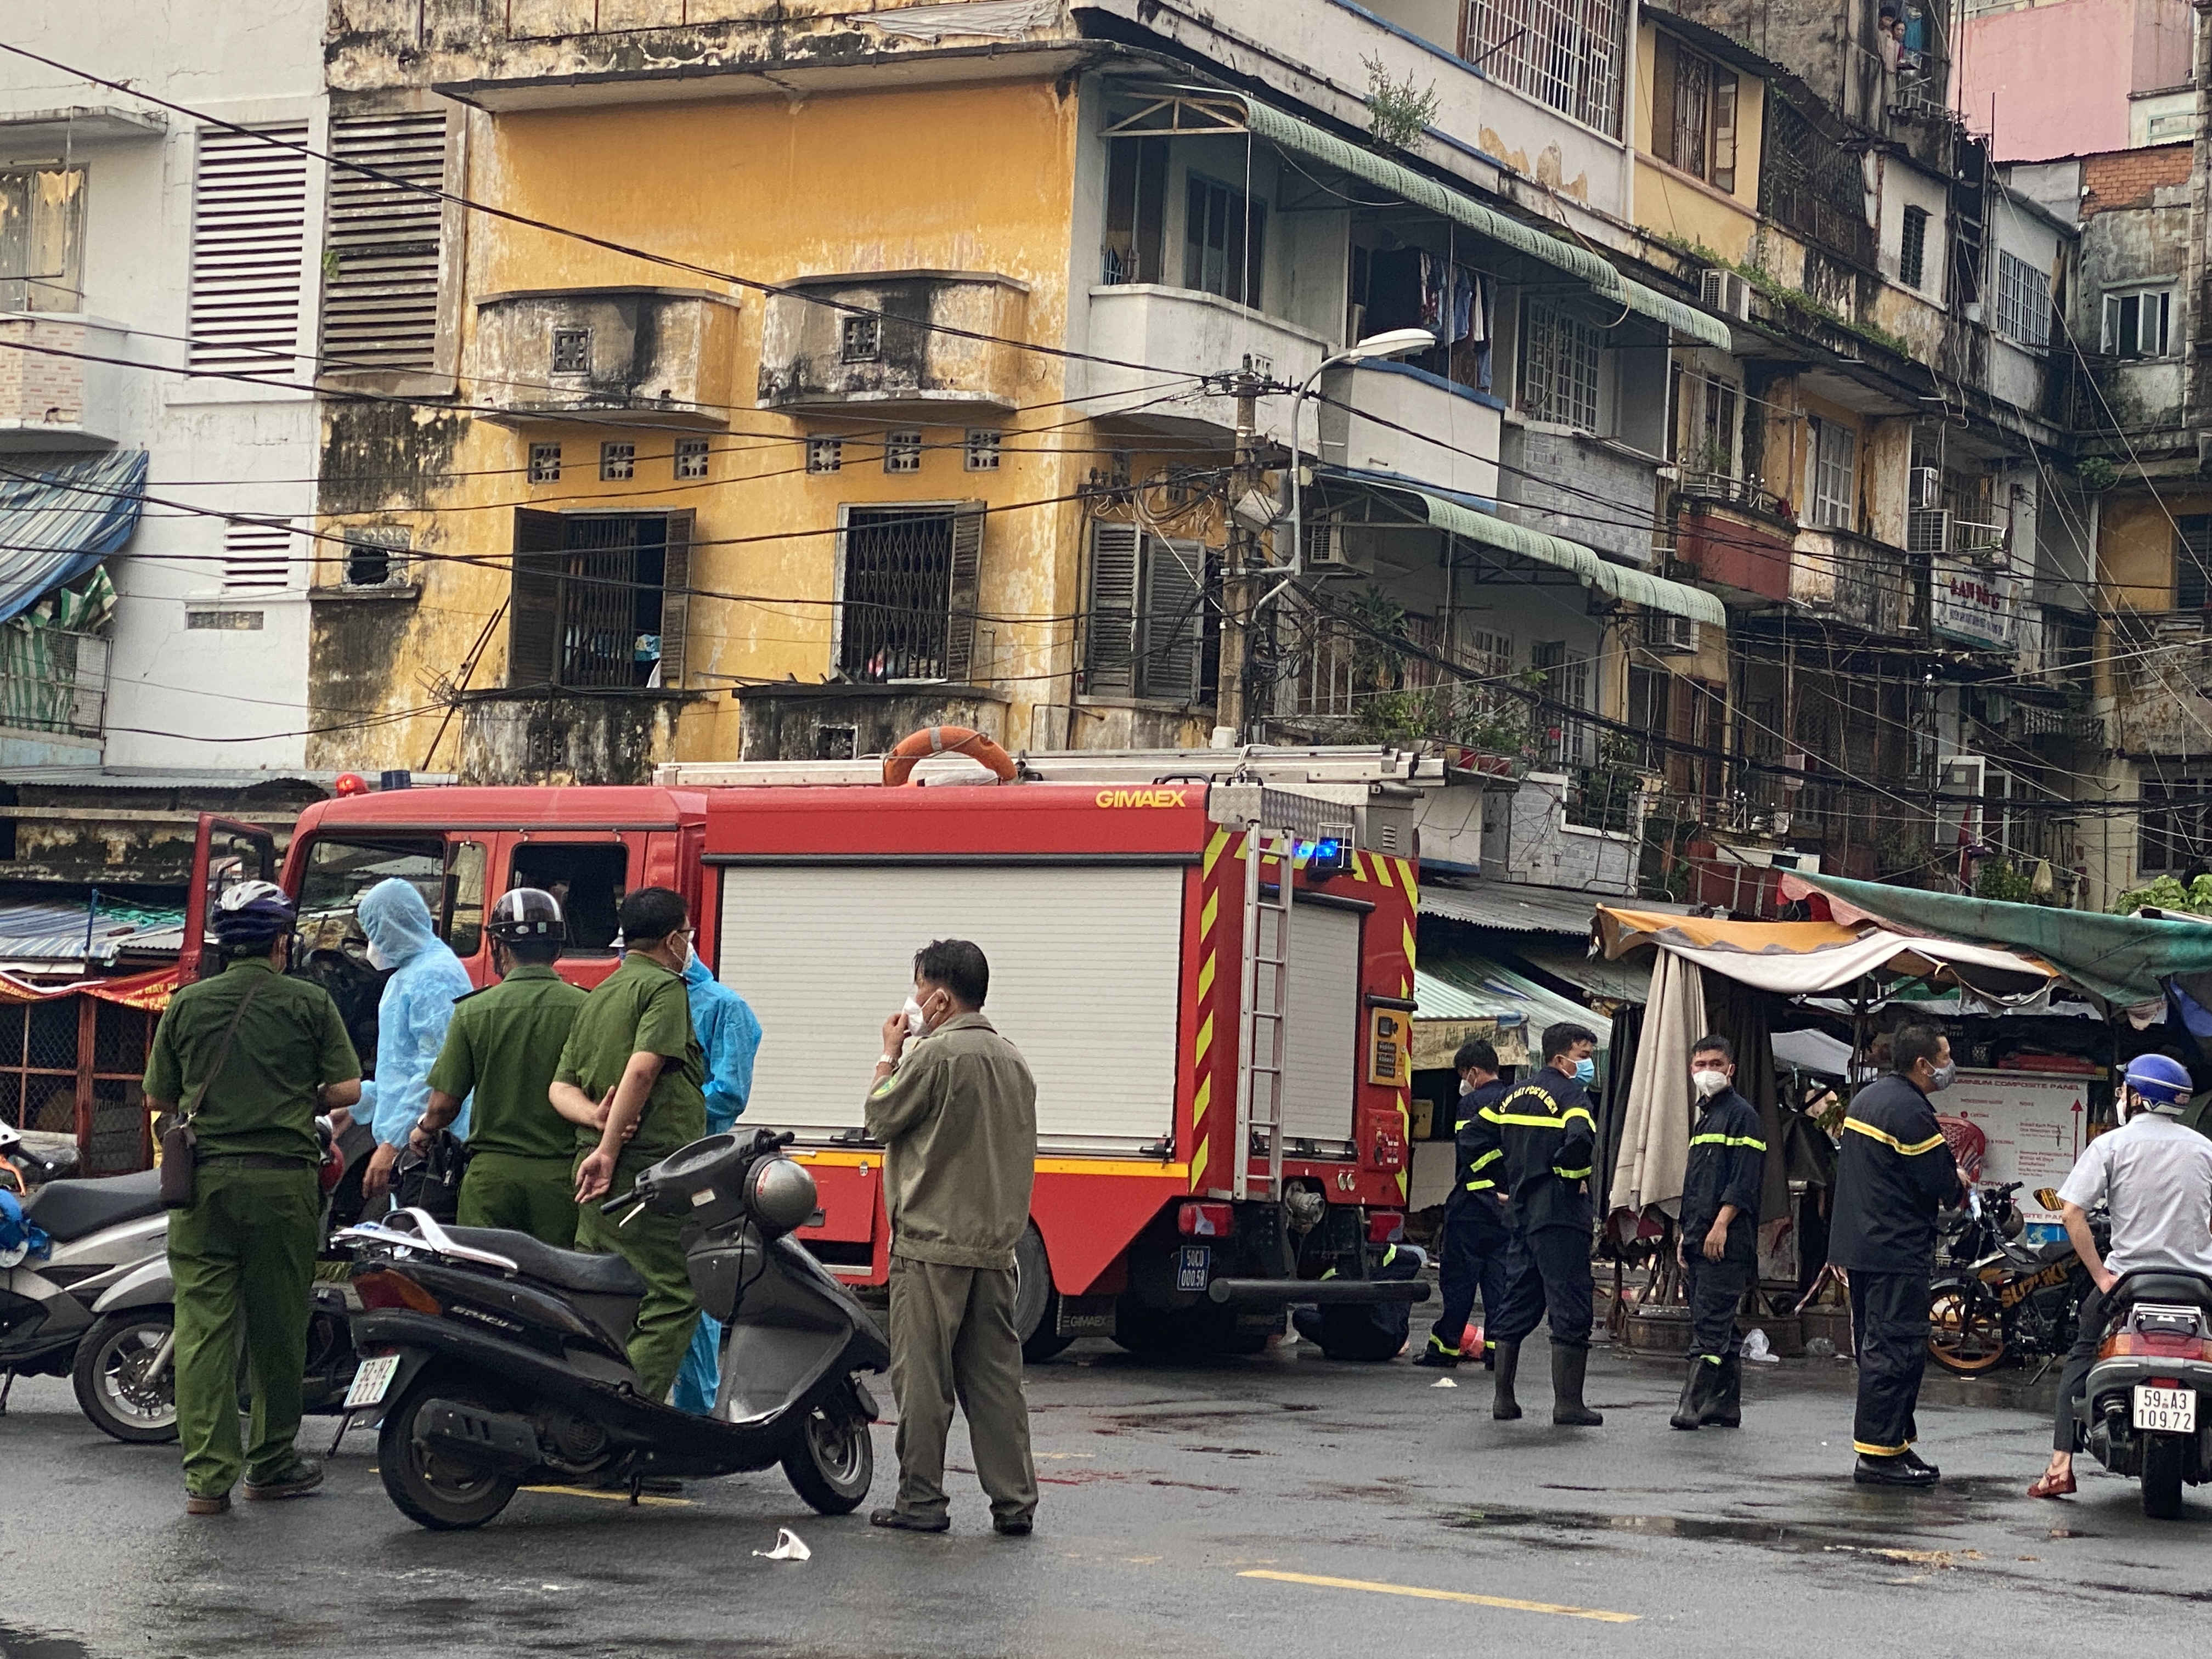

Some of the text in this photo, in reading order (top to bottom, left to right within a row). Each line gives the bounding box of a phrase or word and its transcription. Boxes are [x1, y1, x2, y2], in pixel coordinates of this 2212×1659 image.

[1096, 790, 1187, 808] GIMAEX
[1995, 1080, 2047, 1089] COMPOSITE
[2143, 1390, 2187, 1409] 59-A3
[2138, 1409, 2192, 1430] 109.72
